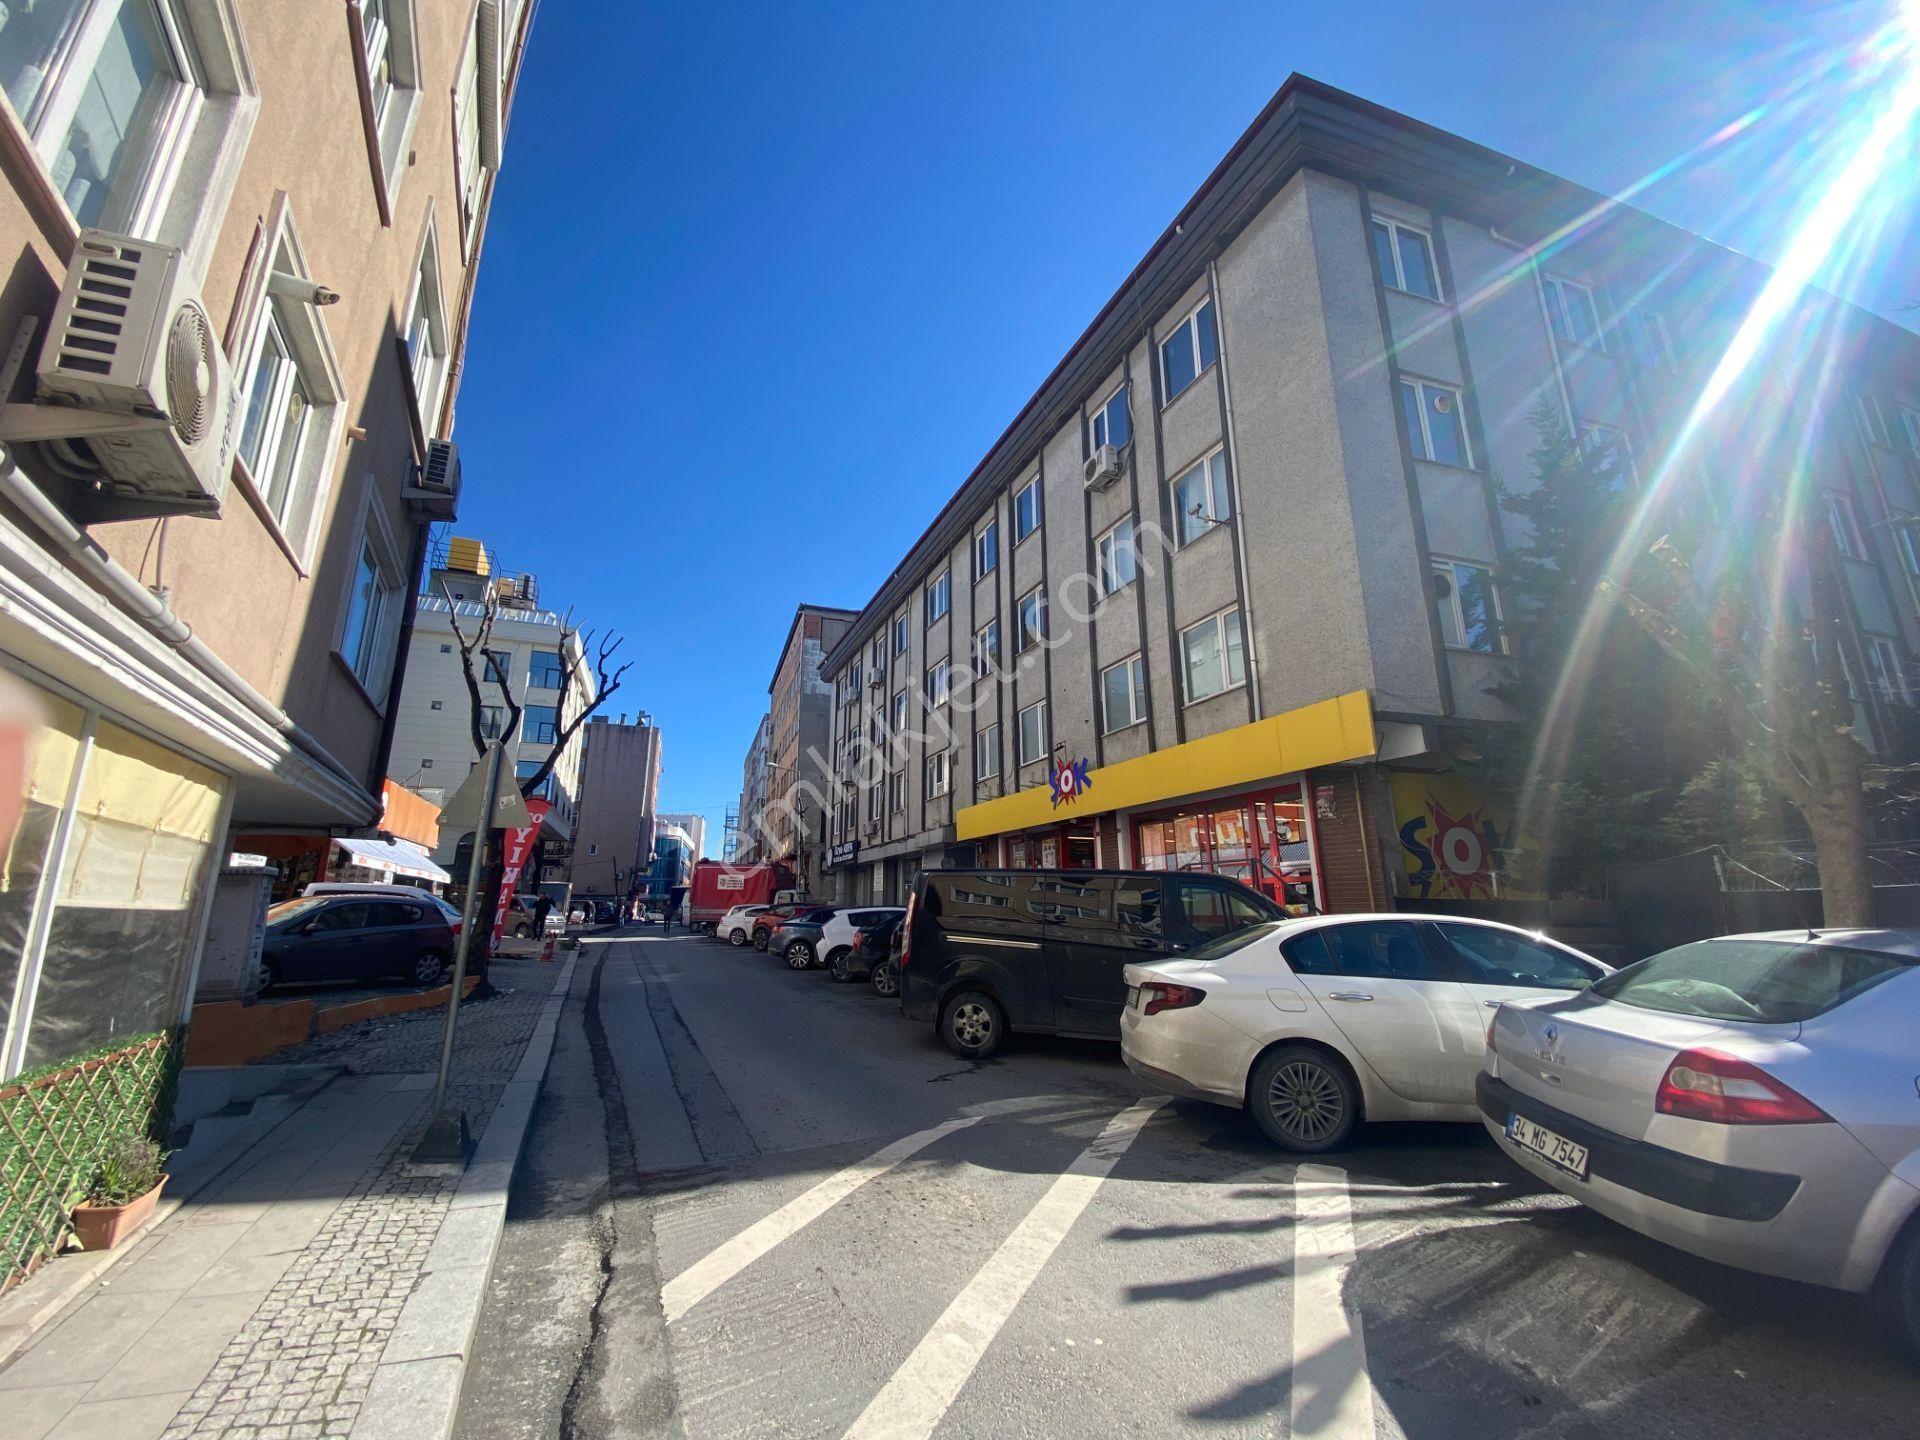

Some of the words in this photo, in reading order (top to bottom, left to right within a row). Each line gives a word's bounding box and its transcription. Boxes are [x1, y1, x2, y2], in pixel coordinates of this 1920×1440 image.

[1049, 757, 1093, 811] ŞOK
[1513, 1117, 1526, 1140] 34
[1531, 1126, 1547, 1150] MG
[1551, 1136, 1587, 1170] 7547
